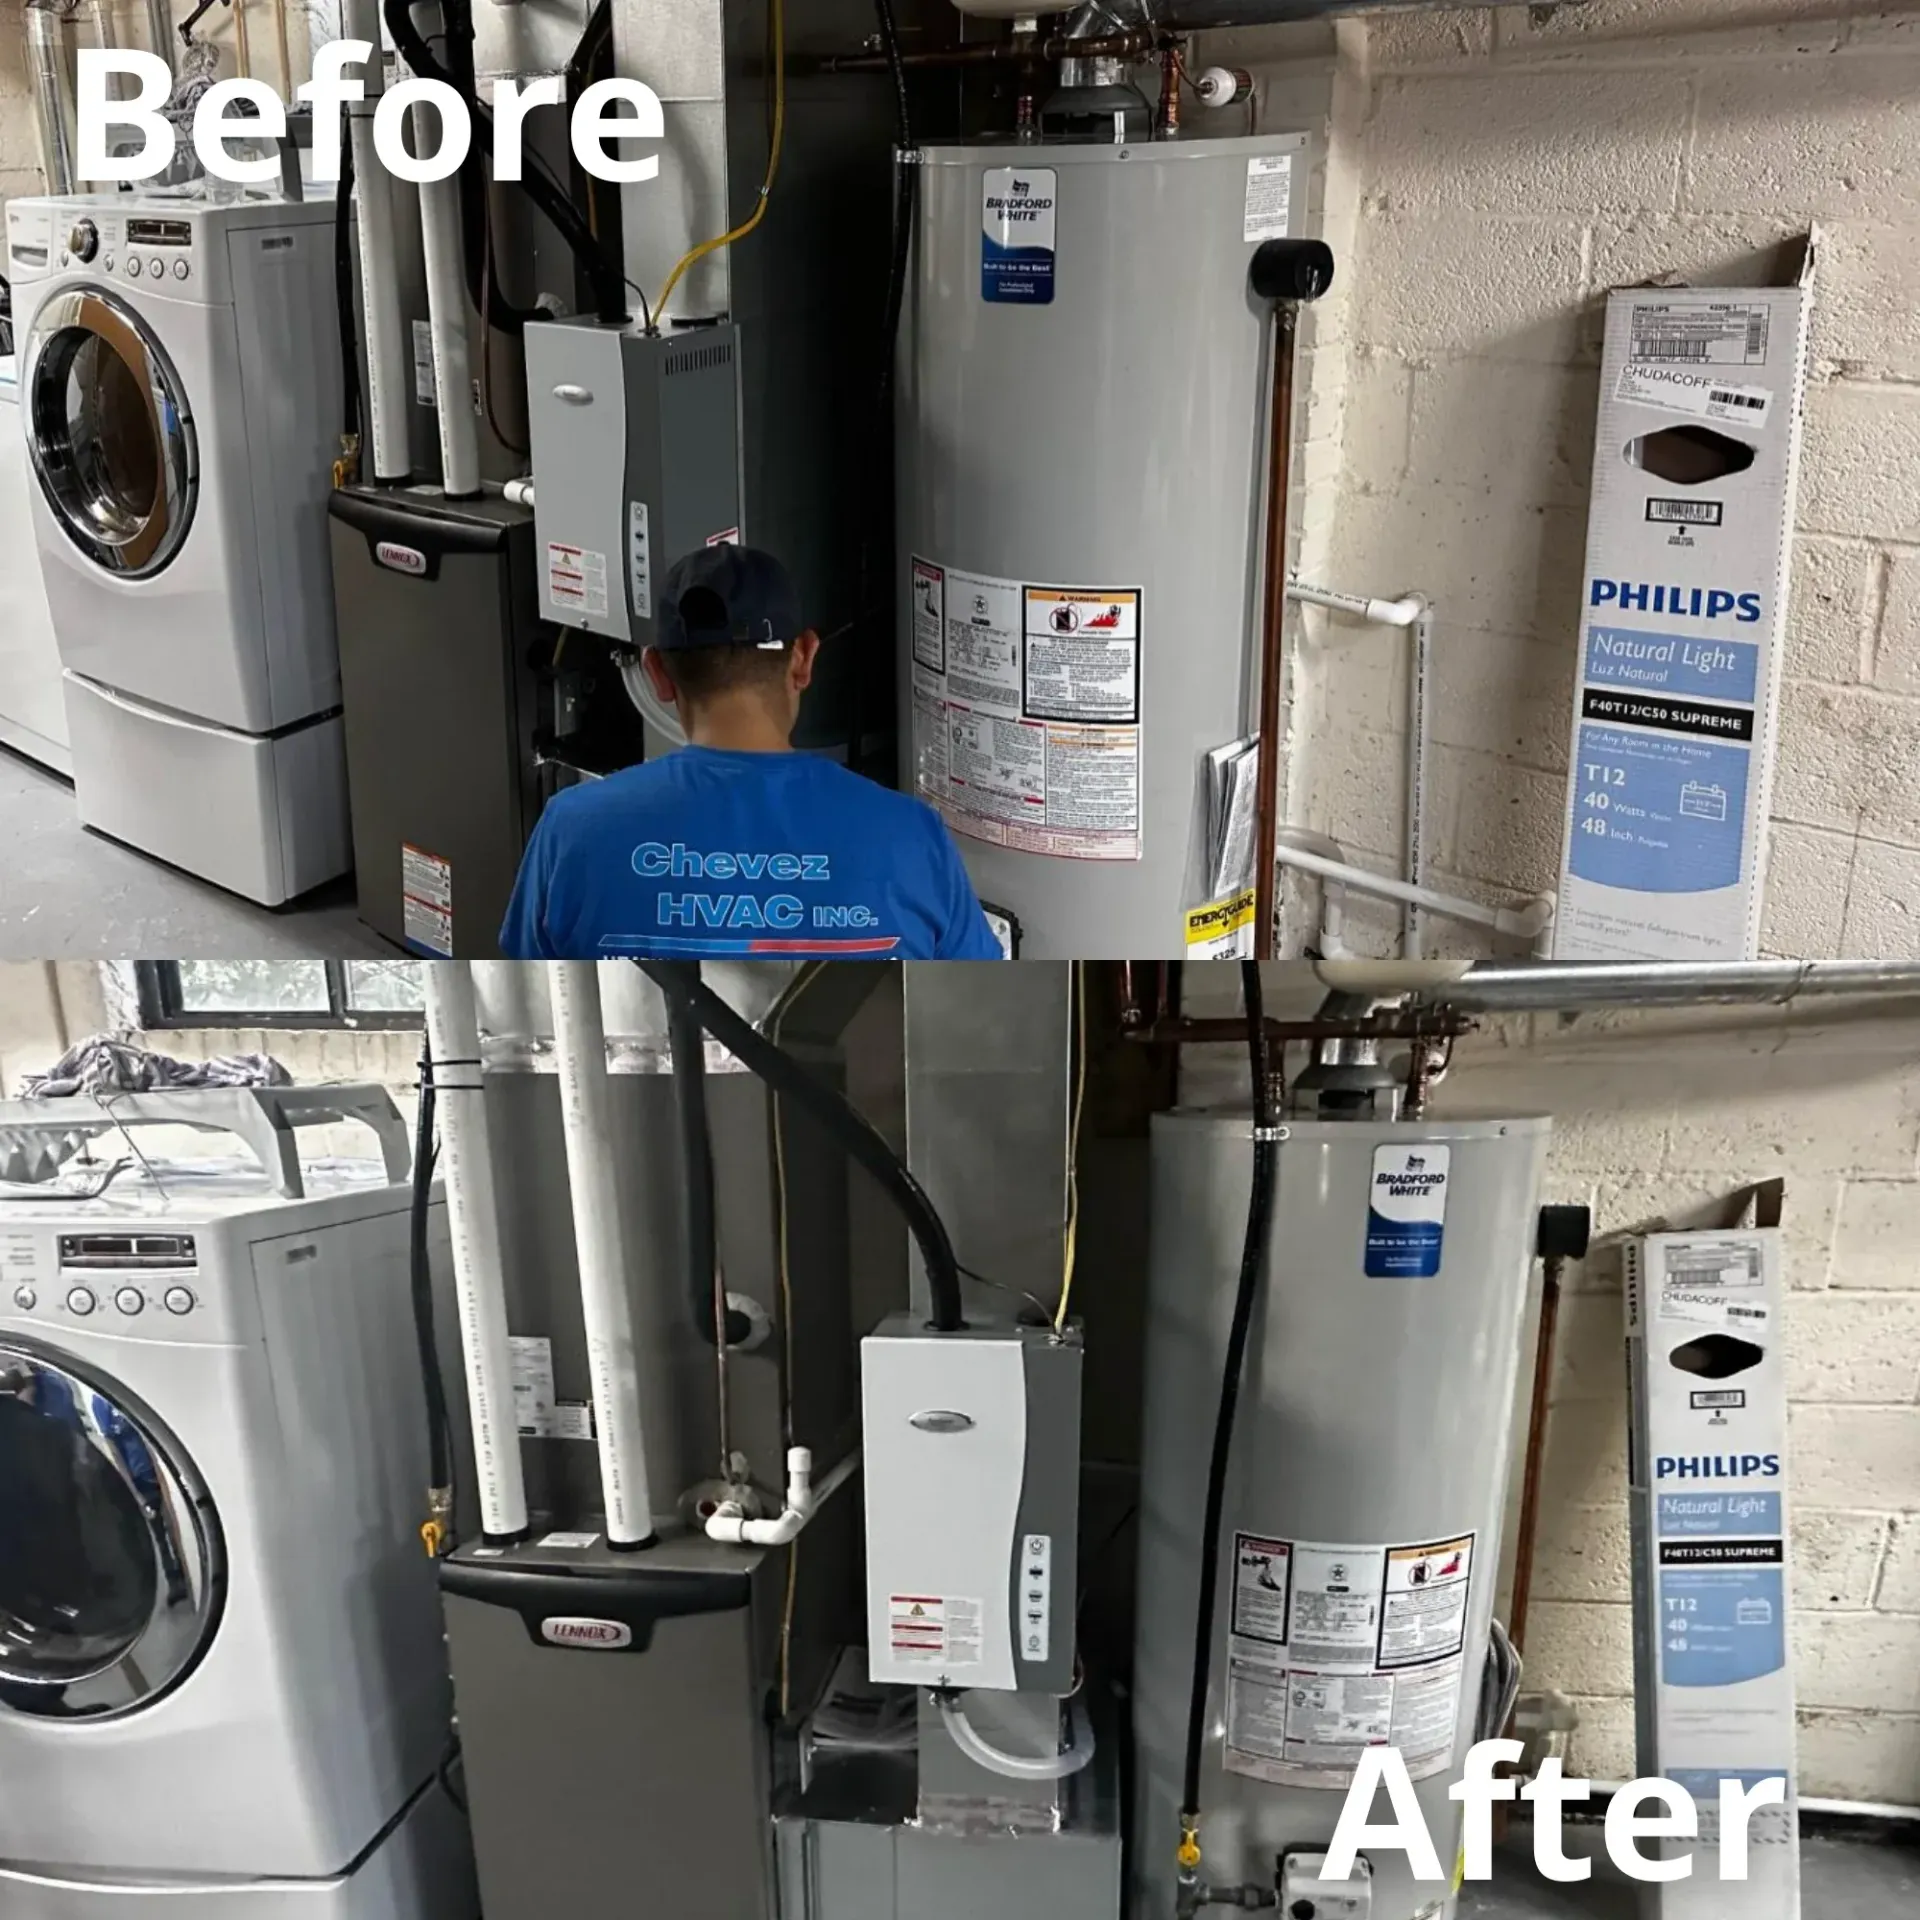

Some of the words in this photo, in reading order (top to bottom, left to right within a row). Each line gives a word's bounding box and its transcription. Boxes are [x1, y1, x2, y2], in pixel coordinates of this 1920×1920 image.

[986, 197, 1053, 209] BRADFORD
[997, 210, 1037, 221] WHITE
[1622, 364, 1711, 389] CHUDACOFF
[1591, 579, 1761, 622] PHILIPS
[1594, 634, 1676, 664] Natural
[1682, 643, 1736, 673] Light
[1591, 663, 1614, 676] Luz
[1618, 666, 1669, 683] Natural
[1589, 699, 1667, 720] F40T12/C50
[1671, 711, 1743, 730] SUPREME
[1584, 763, 1626, 786] T12
[1583, 791, 1609, 810] 40
[1613, 803, 1645, 817] Watts
[1581, 817, 1606, 836] 48
[1610, 828, 1633, 842] Inch
[631, 842, 830, 880] Chevez
[657, 892, 804, 929] HVAC
[812, 905, 880, 928] INC.
[1377, 1173, 1446, 1185] BRADFORD
[1389, 1186, 1431, 1196] WHITE
[1657, 1455, 1780, 1479] PHILIPS
[1663, 1497, 1723, 1515] Natural
[1727, 1496, 1767, 1519] Light
[1724, 1547, 1776, 1557] SUPREME
[1664, 1598, 1698, 1612] T12
[553, 1622, 607, 1641] LENNOX
[1666, 1618, 1688, 1632] 40
